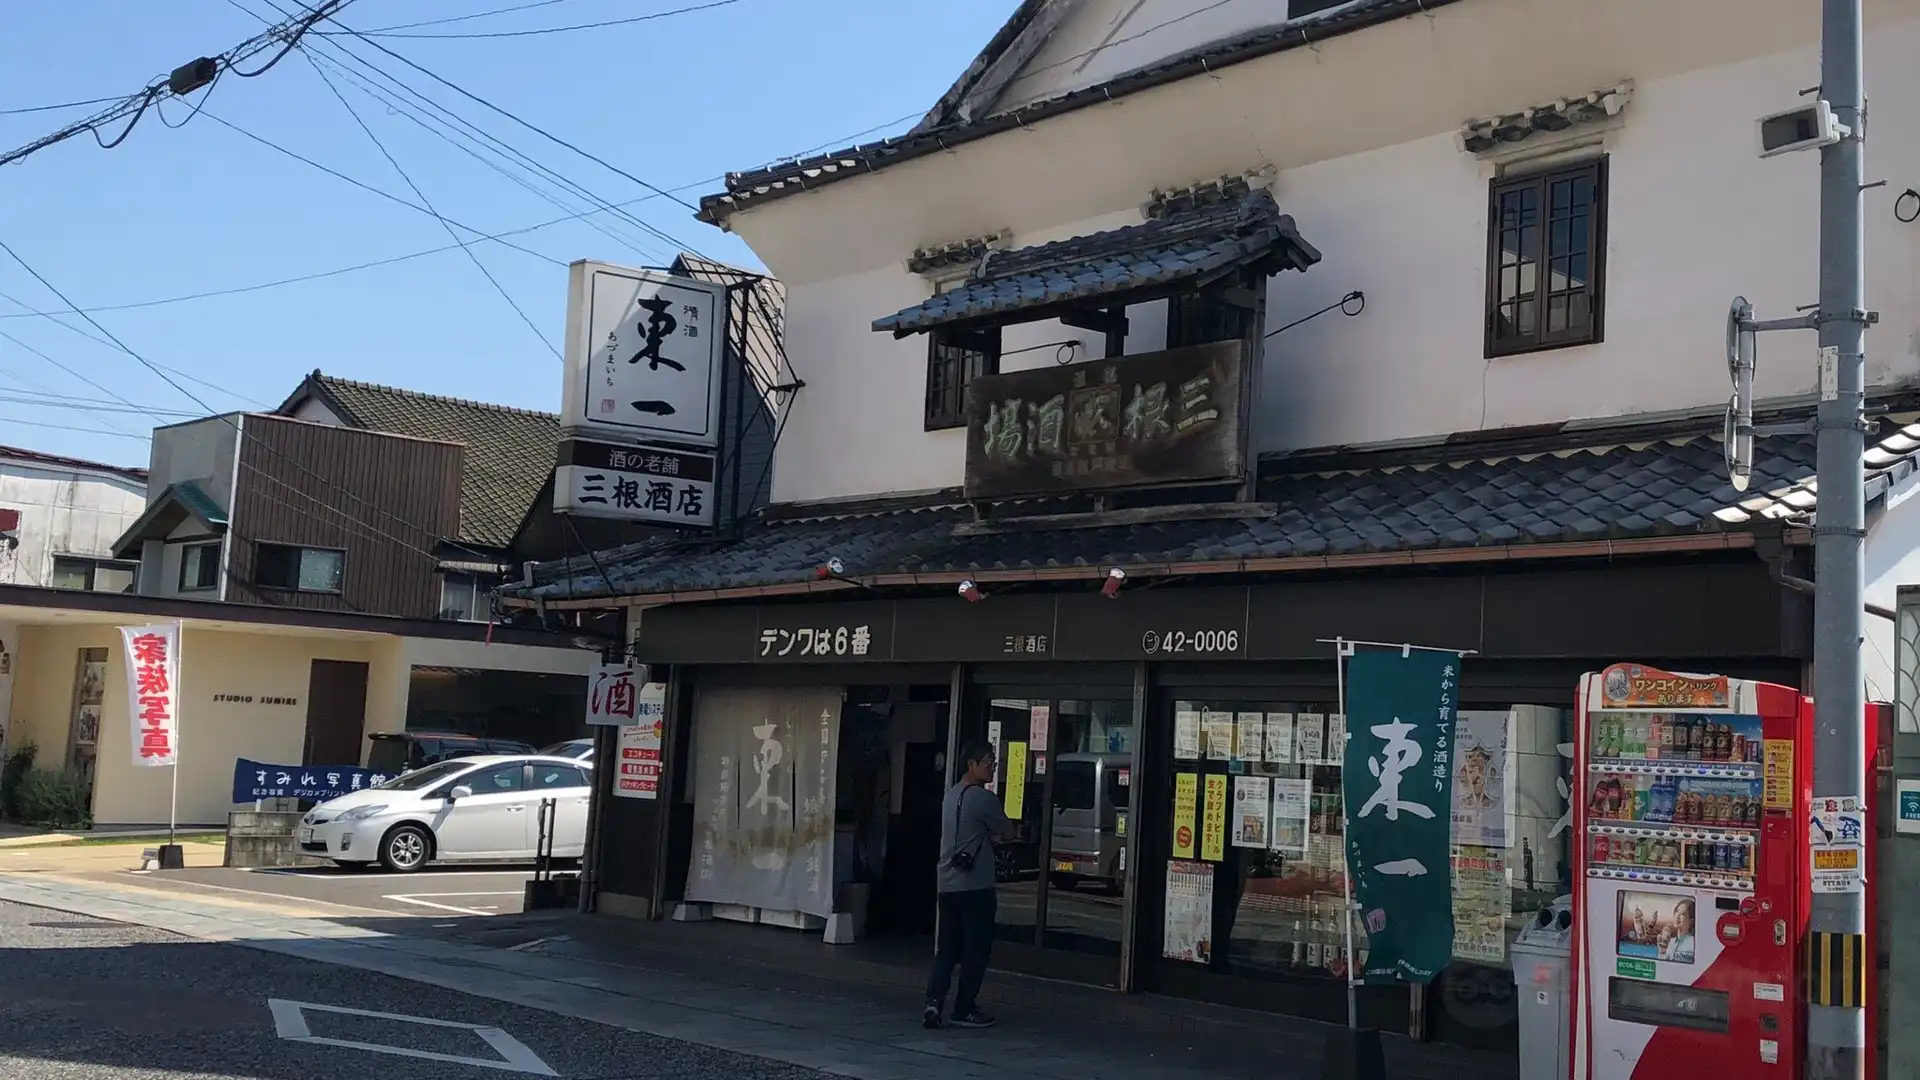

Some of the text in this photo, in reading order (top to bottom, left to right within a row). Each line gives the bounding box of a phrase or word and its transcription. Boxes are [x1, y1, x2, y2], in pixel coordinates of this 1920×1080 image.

[606, 330, 618, 388] あづまいち
[608, 449, 681, 476] 酒の老舗
[577, 473, 704, 517] 三根酒店
[760, 625, 871, 656] デンワは6番
[1162, 629, 1239, 653] 42-0006
[213, 693, 297, 706] STUDIO SUMIRE
[591, 671, 636, 719] 酒
[1432, 663, 1456, 794] 米から育てる酒造り
[1212, 779, 1224, 854] クラフトビール
[1357, 716, 1437, 877] 東一
